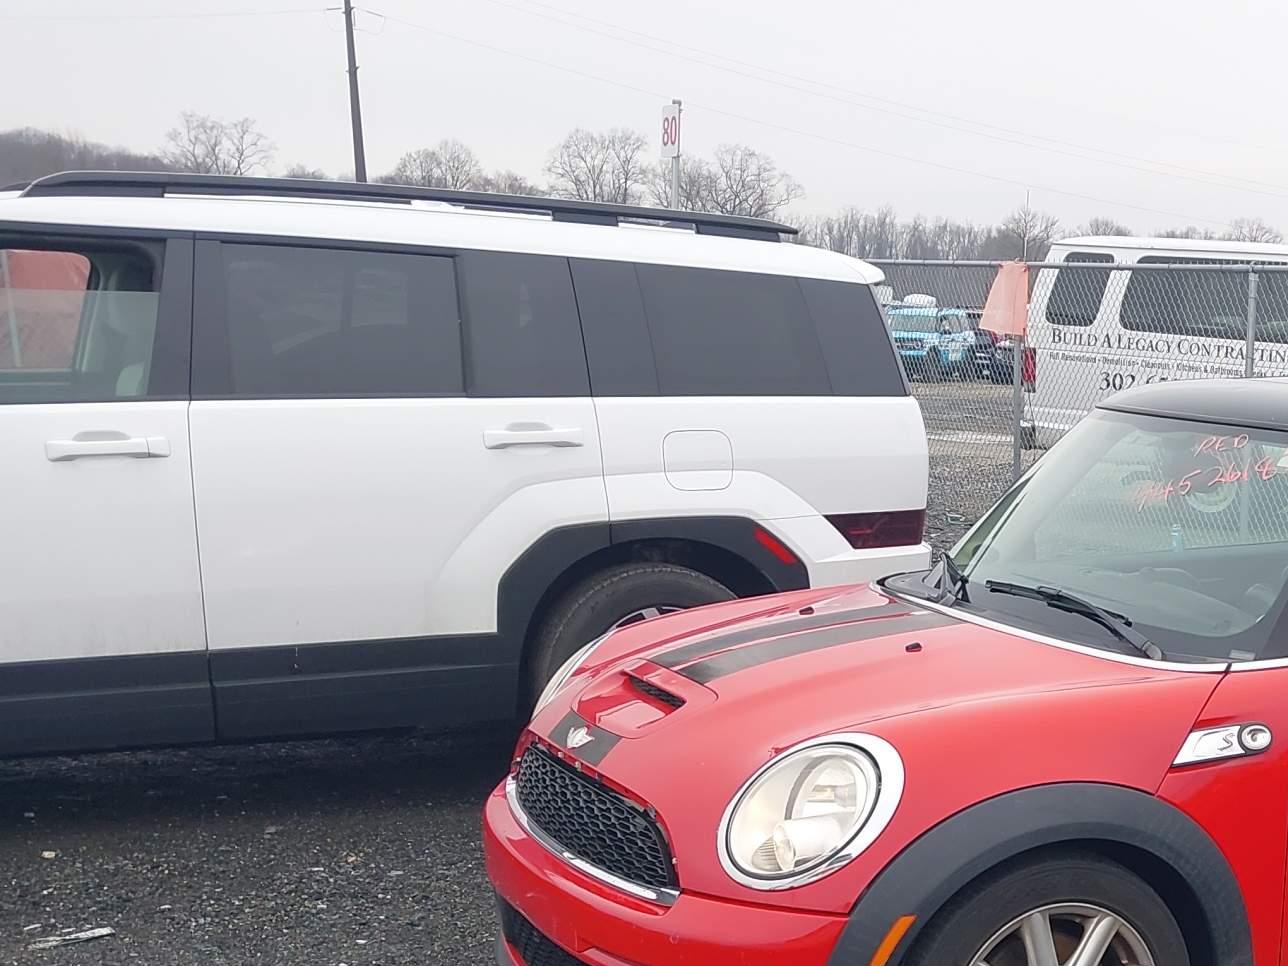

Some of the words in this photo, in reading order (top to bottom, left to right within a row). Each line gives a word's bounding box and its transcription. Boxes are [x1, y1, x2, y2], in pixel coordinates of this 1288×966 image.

[662, 116, 677, 147] 80
[1052, 327, 1098, 347] BUILD
[1101, 333, 1113, 349] A
[1116, 333, 1172, 354] LEGACY
[1194, 433, 1249, 457] RED
